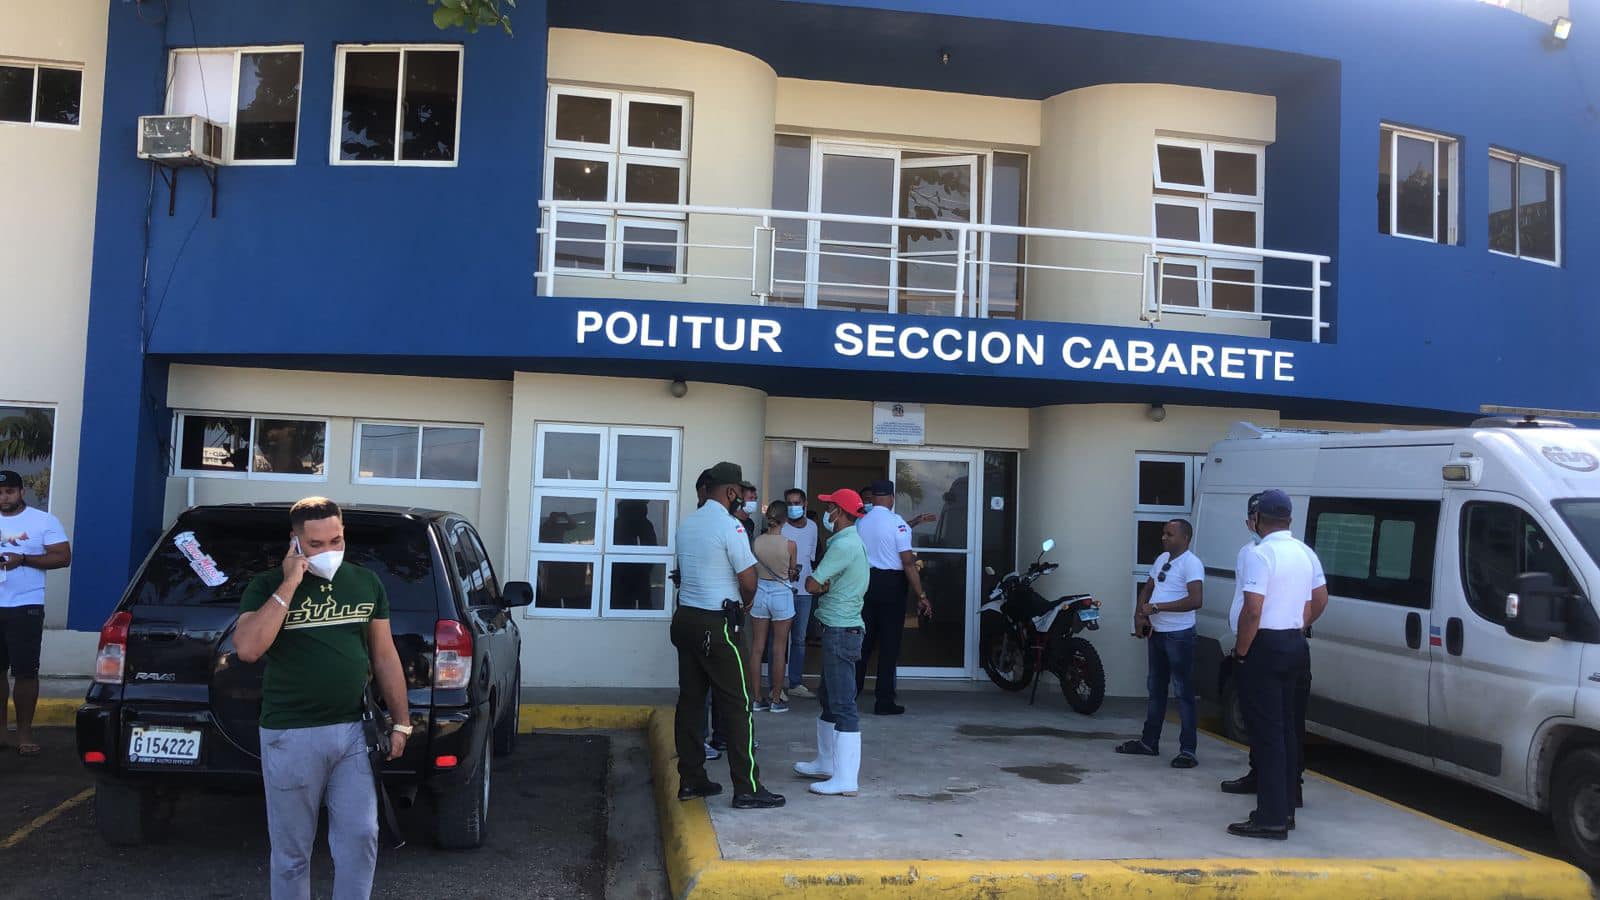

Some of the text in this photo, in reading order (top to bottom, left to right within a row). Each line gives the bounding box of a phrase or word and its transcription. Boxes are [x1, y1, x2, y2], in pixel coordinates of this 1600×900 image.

[576, 310, 1295, 382] POLITUR SECCION CABARETE
[286, 595, 375, 624] BULLS
[133, 736, 195, 756] G154222
